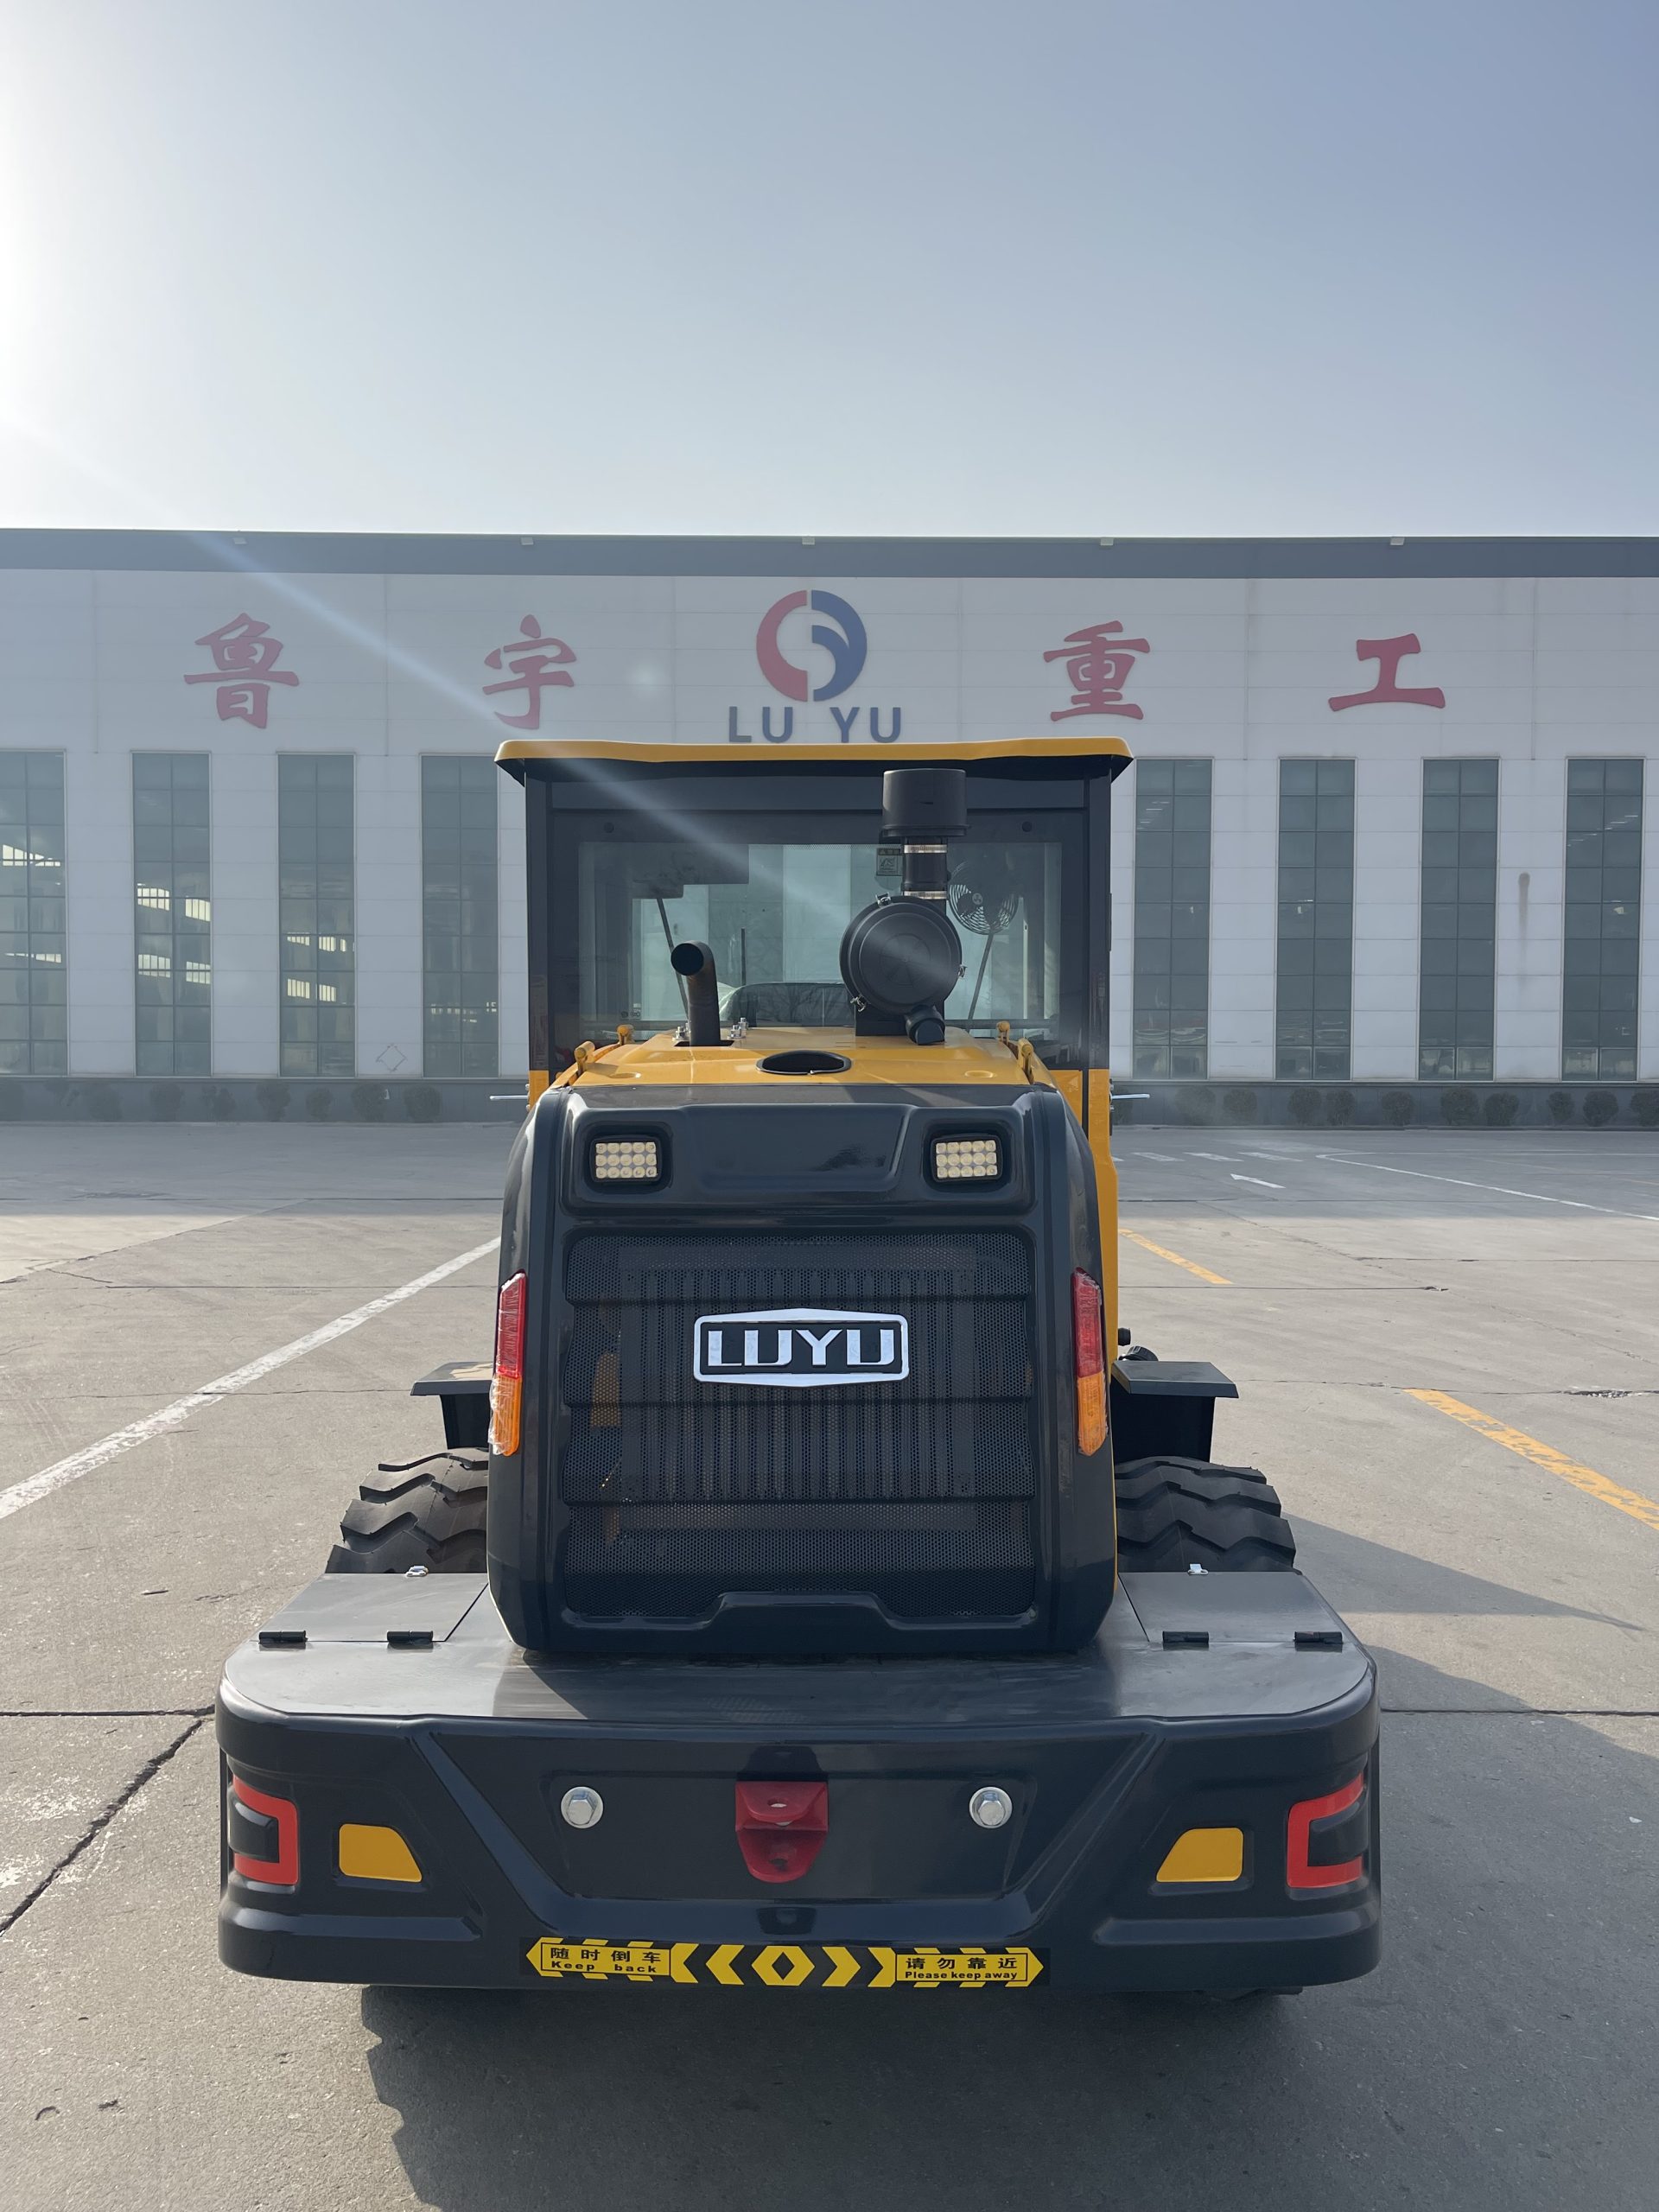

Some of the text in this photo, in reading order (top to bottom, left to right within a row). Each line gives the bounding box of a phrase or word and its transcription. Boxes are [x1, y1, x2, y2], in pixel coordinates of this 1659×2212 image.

[728, 706, 901, 743] LU YU
[708, 1329, 894, 1366] LUYU
[550, 1948, 661, 1963] 随时倒车
[551, 1961, 657, 1974] Keep back
[906, 1957, 1018, 1970] 请勿靠近
[950, 1971, 981, 1980] keep
[984, 1972, 1018, 1980] away
